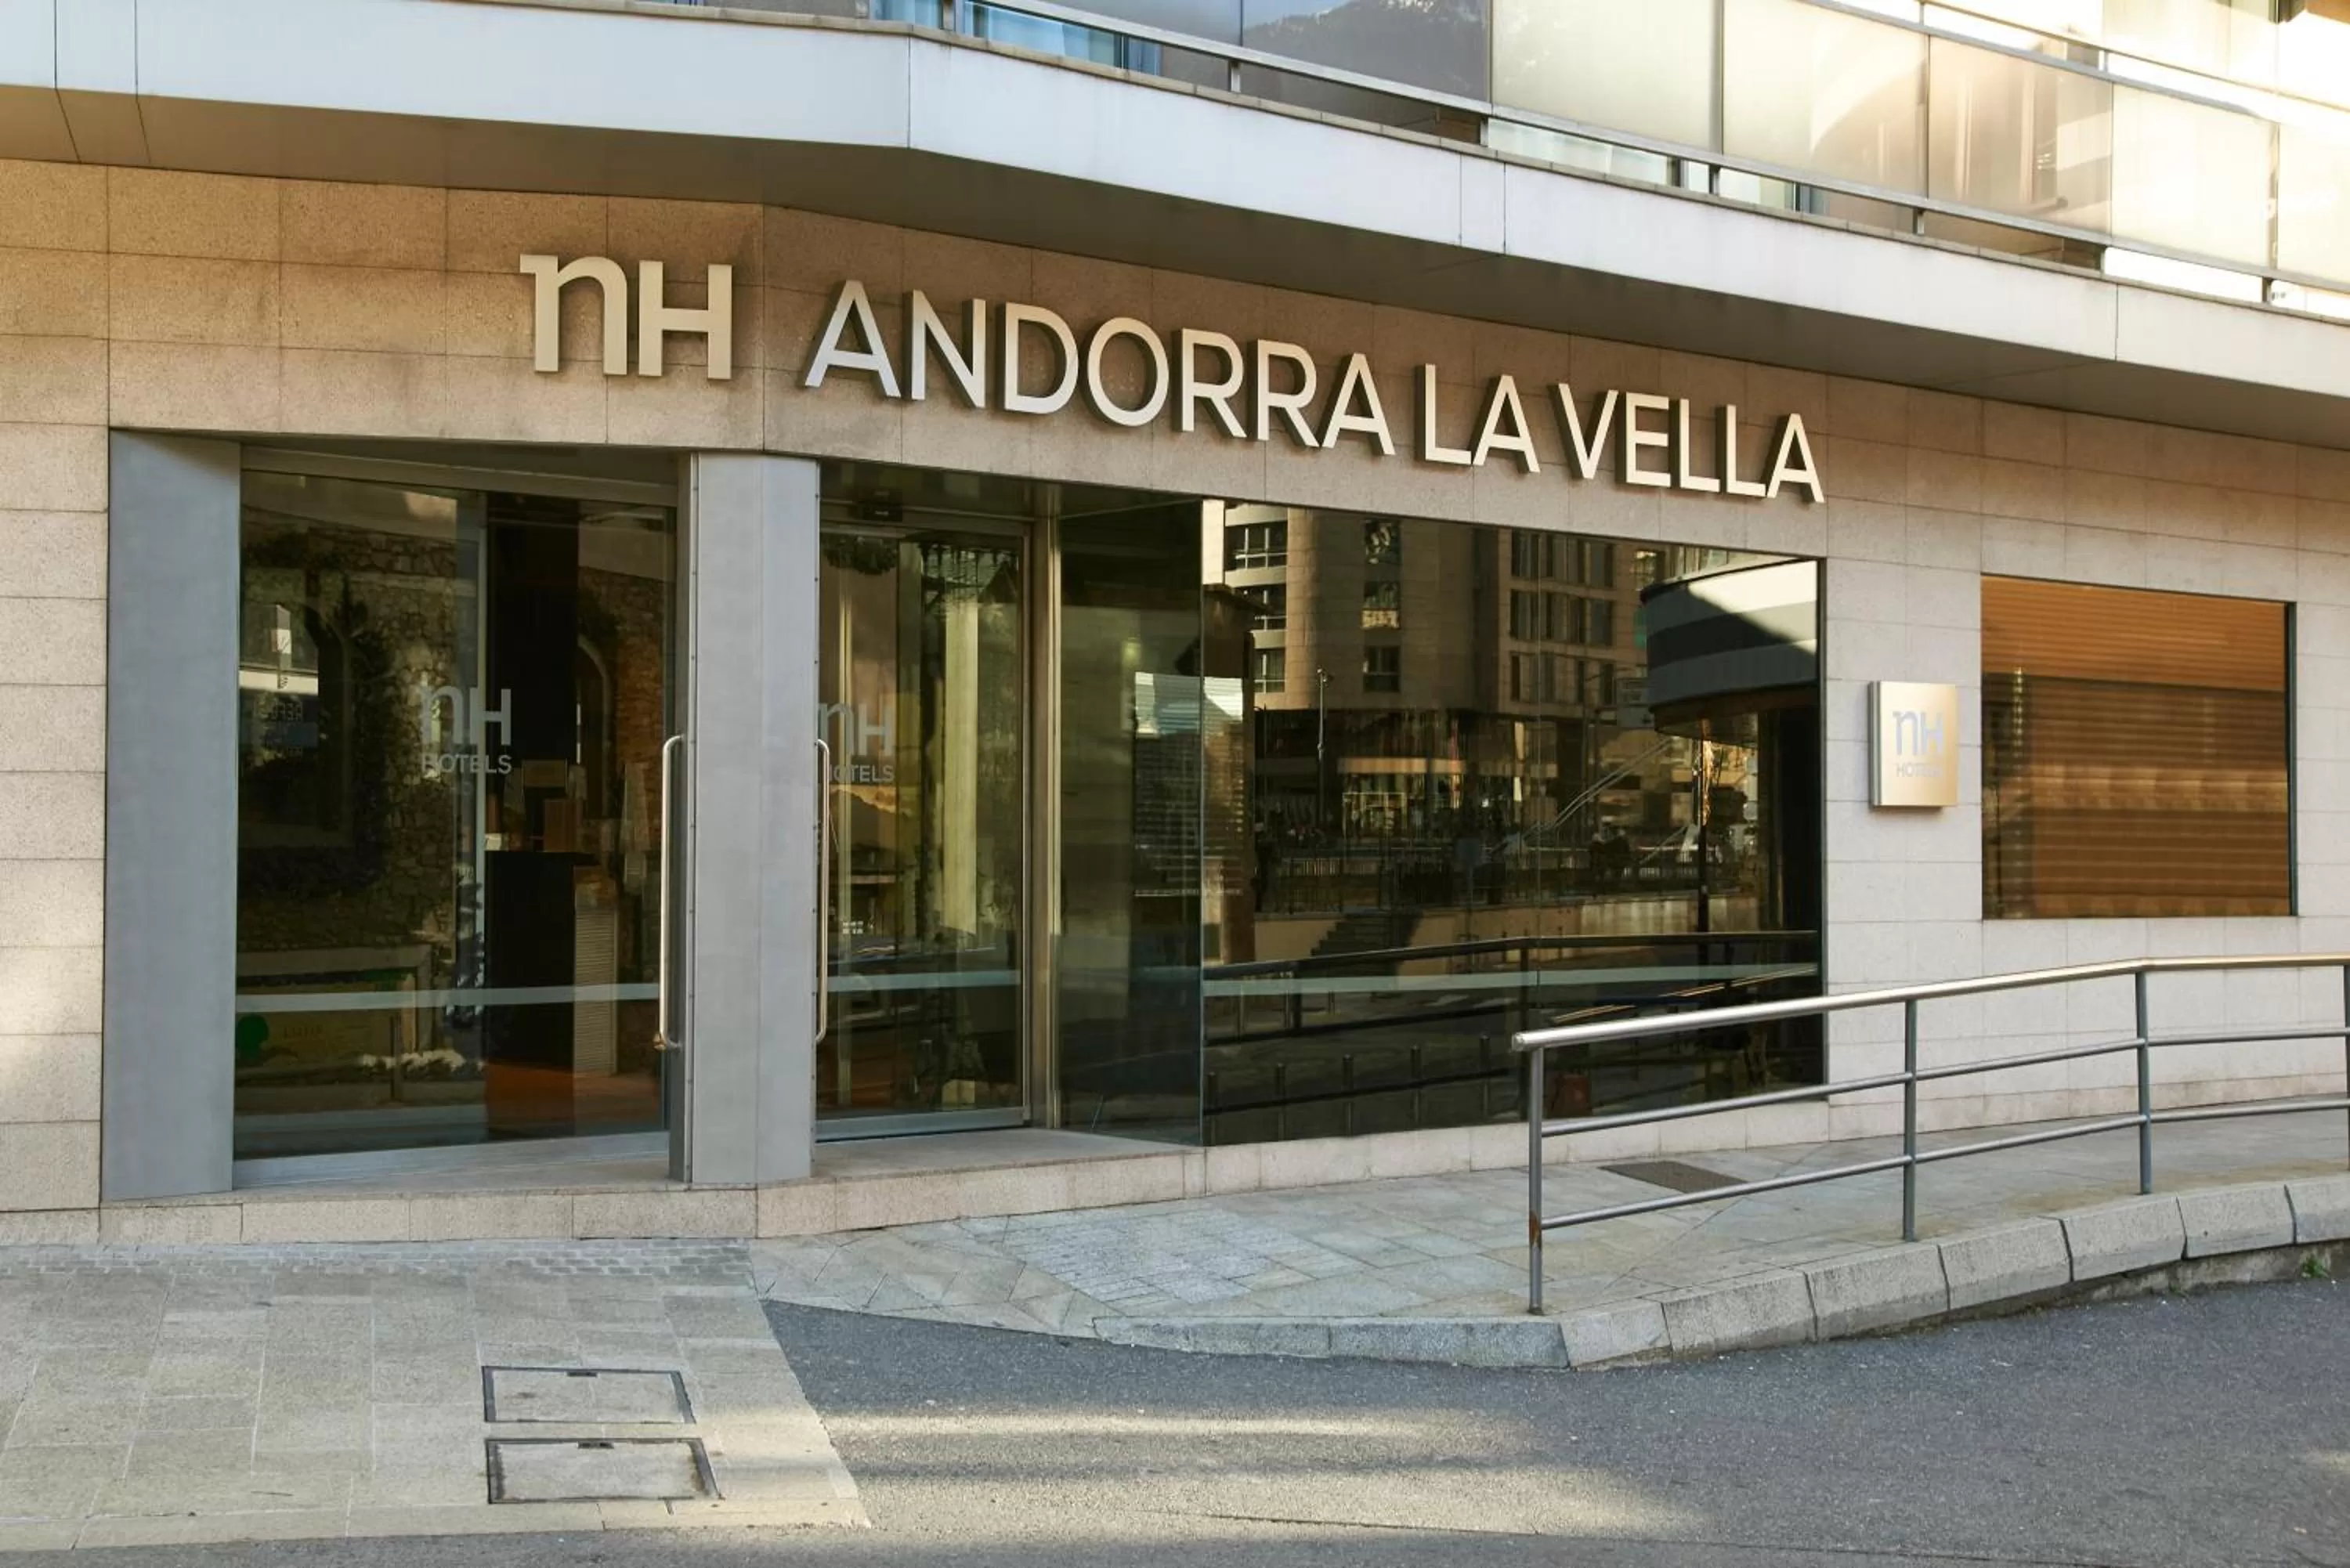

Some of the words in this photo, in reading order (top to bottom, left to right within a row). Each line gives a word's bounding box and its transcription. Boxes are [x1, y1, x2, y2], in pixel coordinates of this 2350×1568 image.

[804, 279, 1397, 457] ANDORRA
[1418, 363, 1541, 474] LA
[1554, 382, 1825, 504] VELLA
[421, 754, 512, 775] HOTELS
[1896, 762, 1943, 778] HOT
